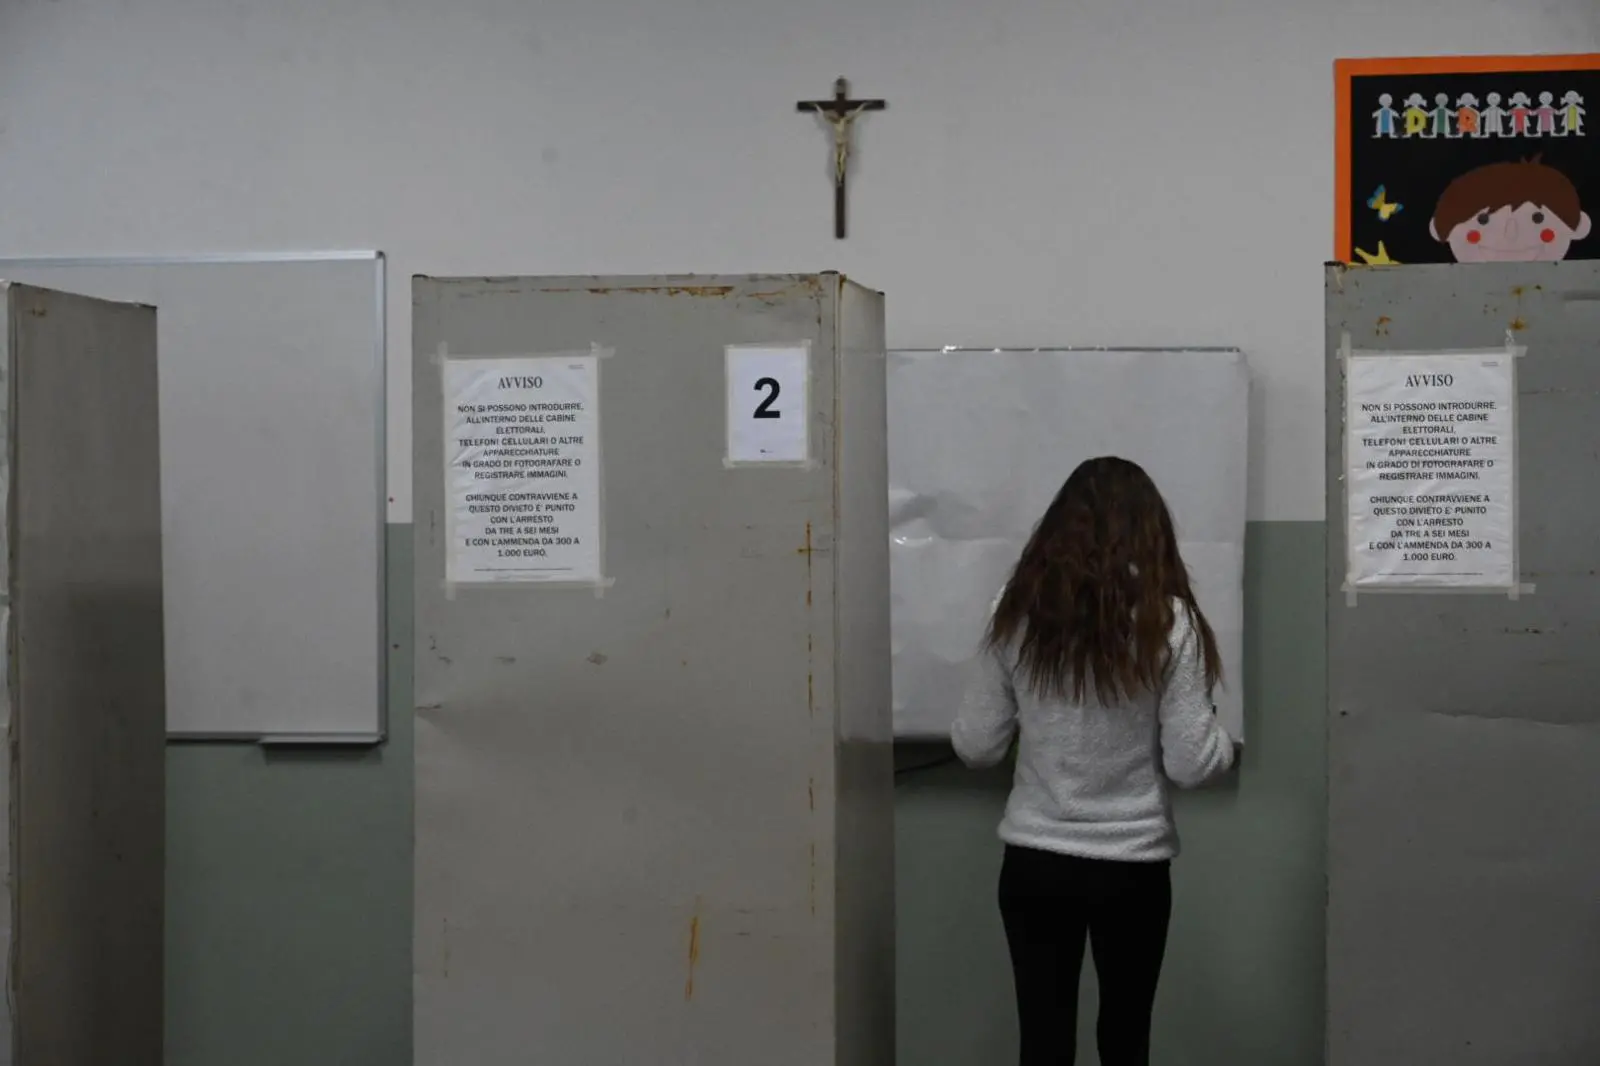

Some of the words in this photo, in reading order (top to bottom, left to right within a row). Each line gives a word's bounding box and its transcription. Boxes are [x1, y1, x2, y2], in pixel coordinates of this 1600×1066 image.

[498, 376, 543, 389] AVVISO
[1406, 374, 1453, 387] AVVISO
[753, 377, 781, 418] 2
[458, 405, 475, 413] NON
[1394, 403, 1436, 411] POSSONO
[546, 414, 576, 422] CABINE
[1371, 415, 1425, 423] ALL'INTERNO
[1428, 414, 1454, 422] DELLE
[483, 448, 559, 456] APPARECCHIATURE
[514, 459, 572, 467] FOTOGRAFARE
[1366, 461, 1375, 469] IN
[1377, 460, 1408, 468] GRADO
[1411, 460, 1420, 468] DI
[1422, 460, 1485, 468] FOTOGRAFARE
[474, 471, 525, 479] REGISTRARE
[1379, 472, 1433, 480] REGISTRARE
[466, 494, 506, 502] CHIUNQUE
[508, 493, 569, 501] CONTRAVVIENE
[1370, 496, 1414, 504] CHIUNQUE
[1416, 495, 1481, 503] CONTRAVVIENE
[469, 505, 500, 513] QUESTO
[1374, 507, 1407, 516] QUESTO
[1455, 506, 1486, 514] PUNITO
[1417, 518, 1463, 526] L'ARRESTO
[1448, 529, 1469, 537] MESI
[1397, 541, 1448, 549] L'AMMENDA
